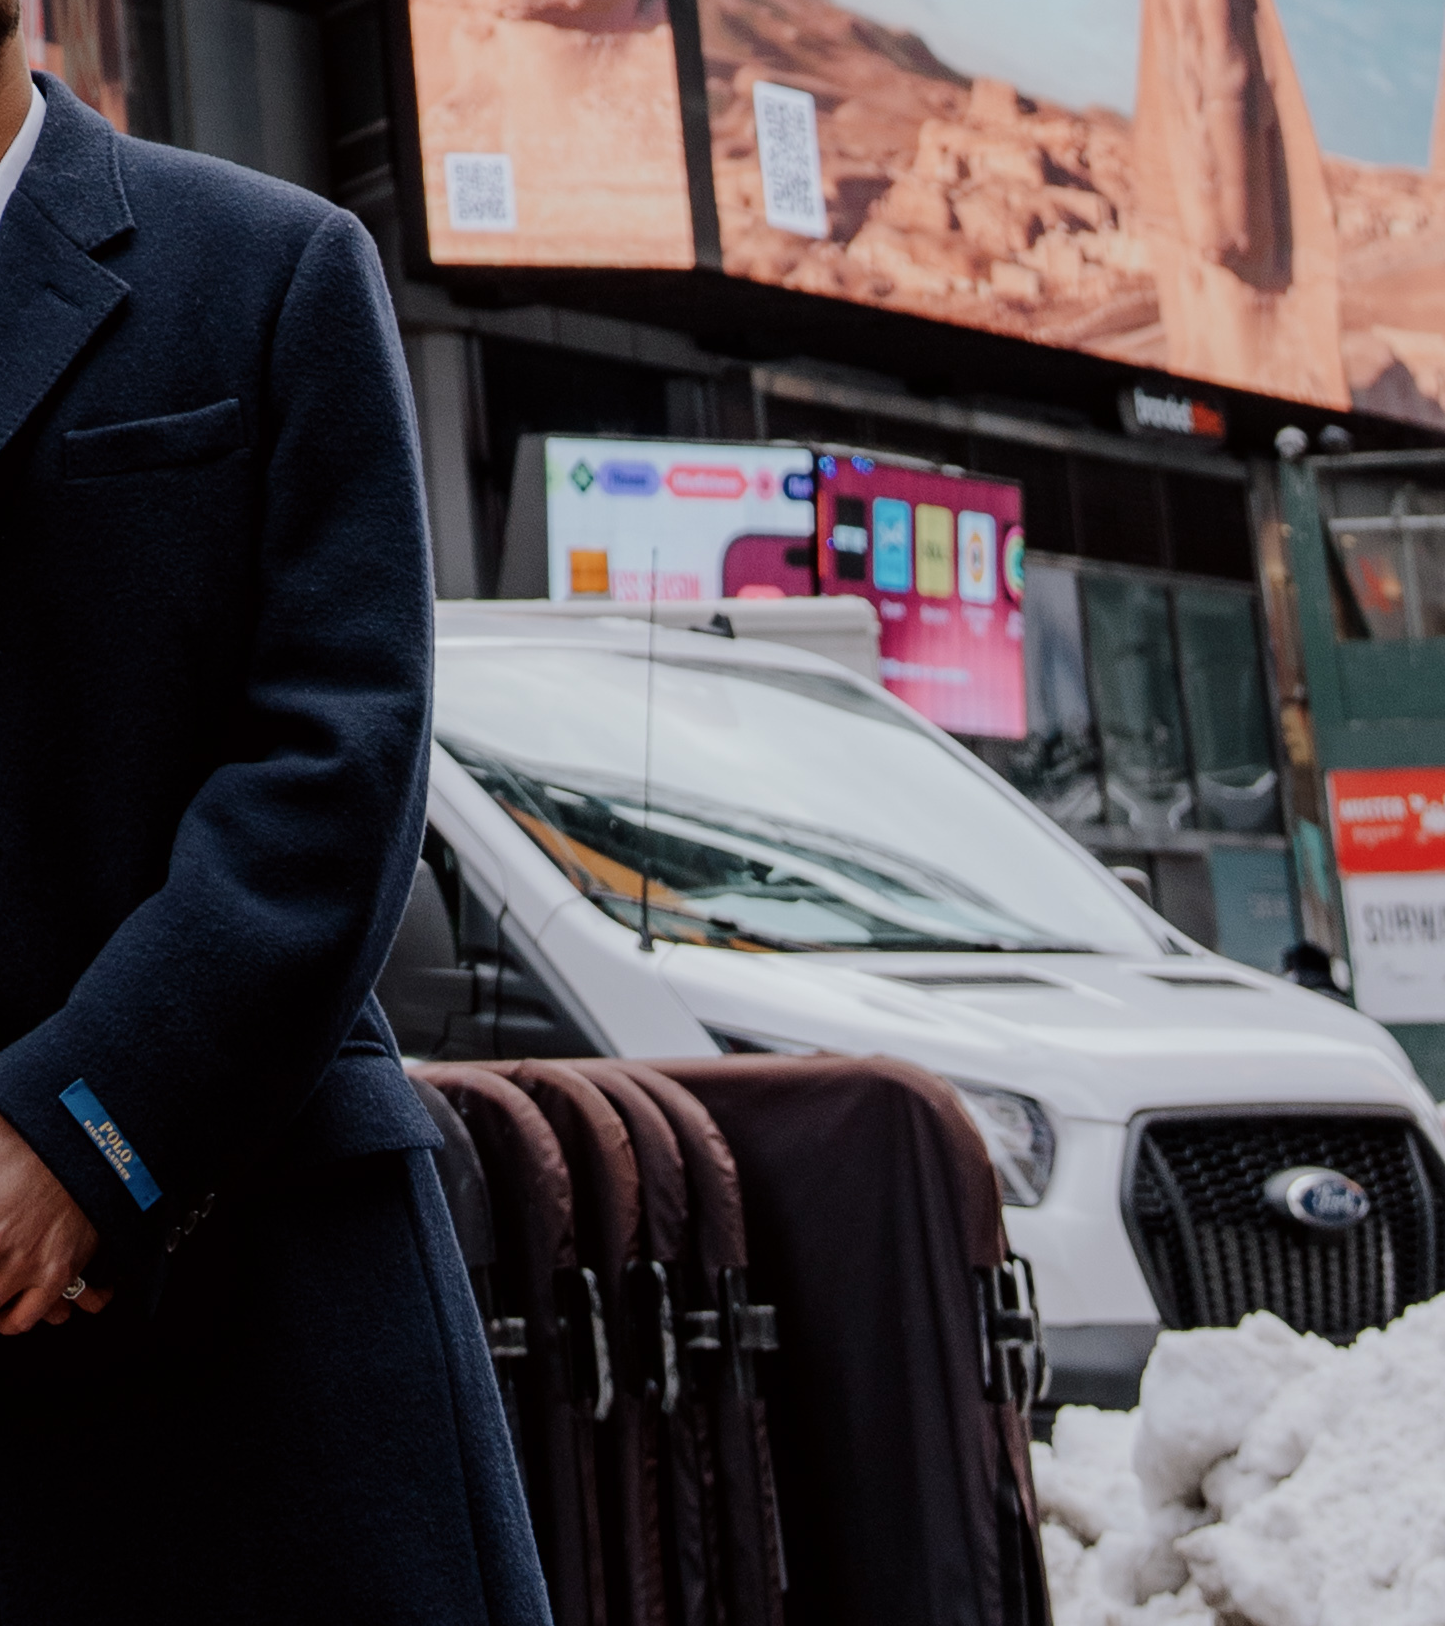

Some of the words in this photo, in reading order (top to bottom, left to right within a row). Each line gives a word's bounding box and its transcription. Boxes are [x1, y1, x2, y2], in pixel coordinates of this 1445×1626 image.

[83, 1119, 107, 1148] RALPH
[104, 1148, 131, 1181] LAUREN
[98, 1120, 133, 1163] POLO
